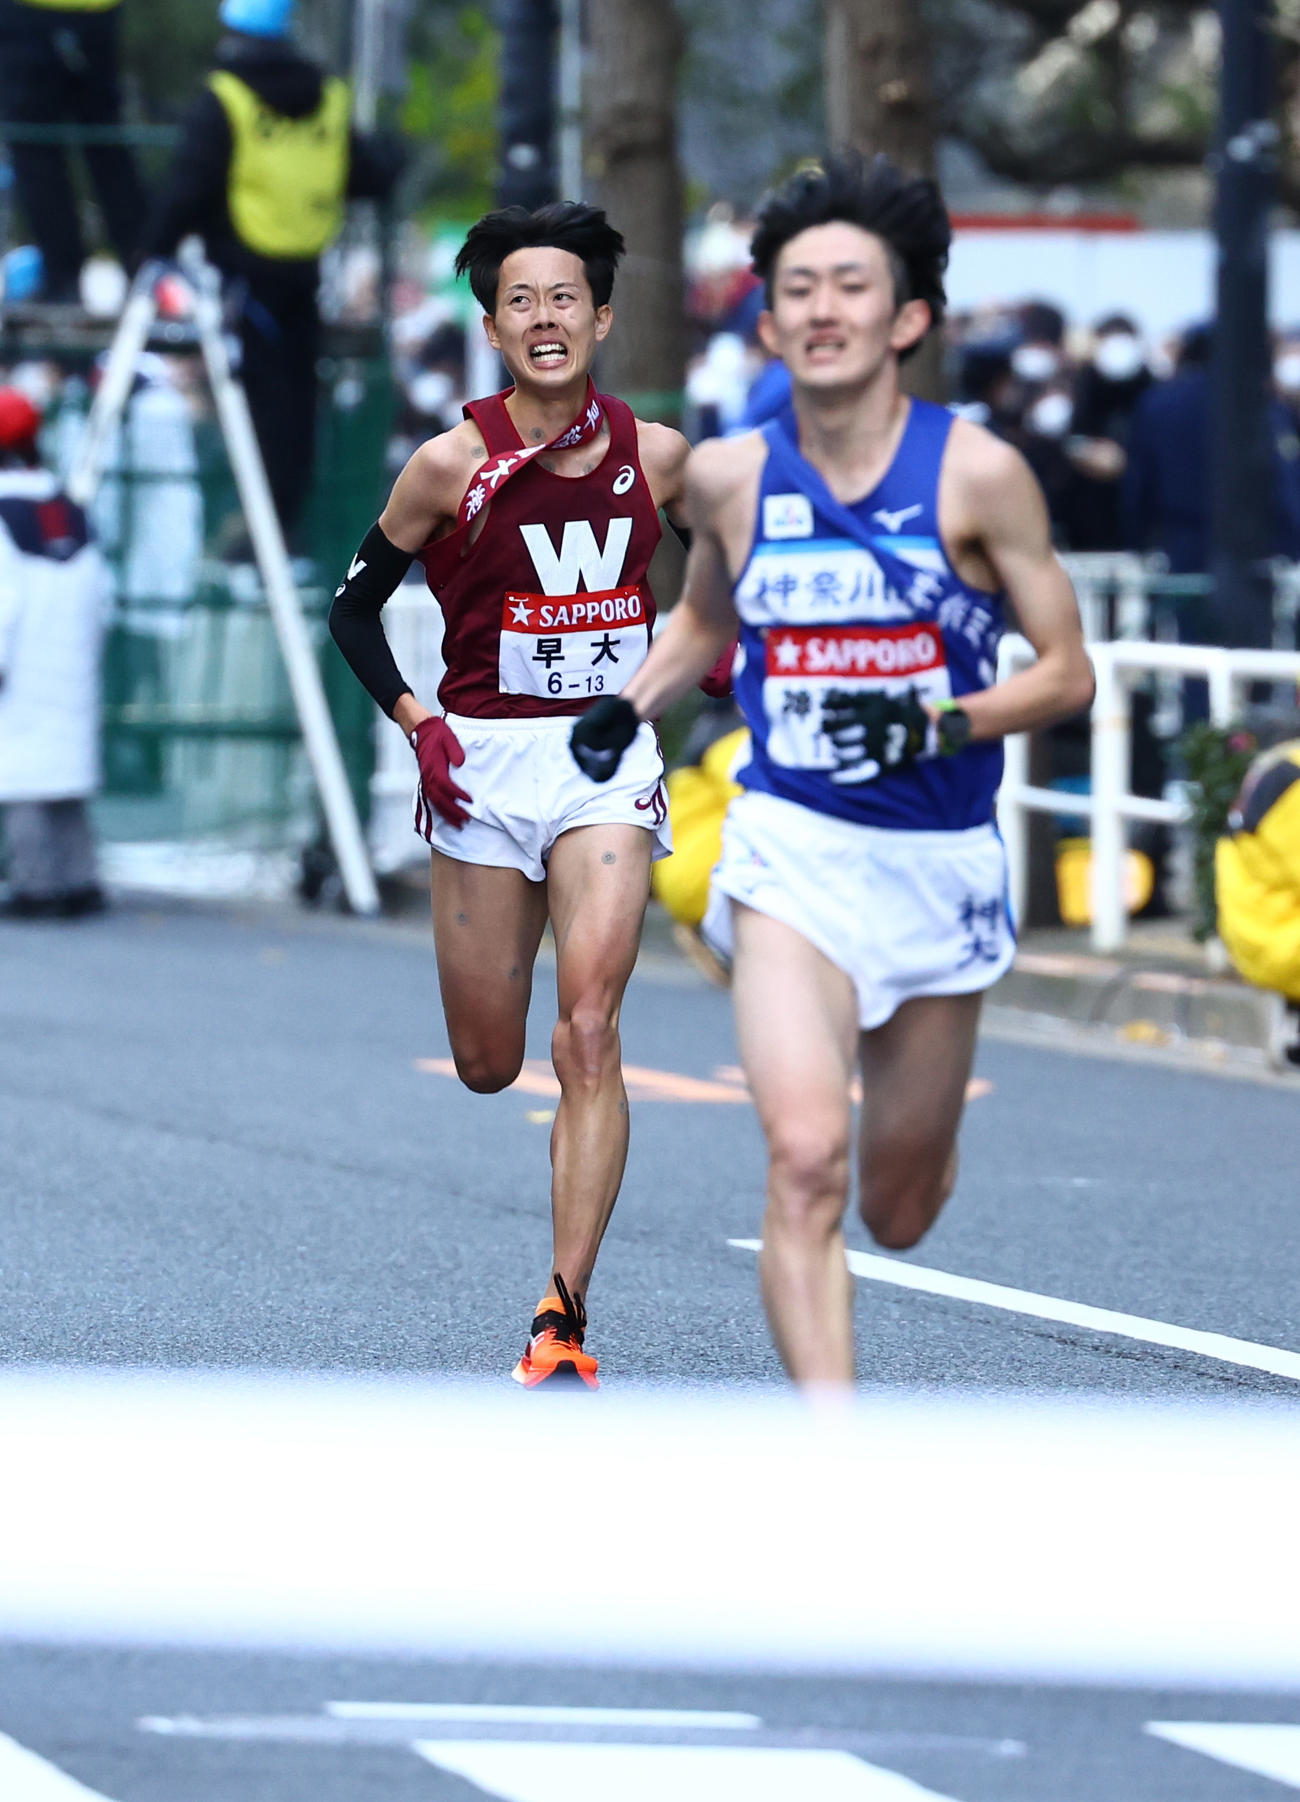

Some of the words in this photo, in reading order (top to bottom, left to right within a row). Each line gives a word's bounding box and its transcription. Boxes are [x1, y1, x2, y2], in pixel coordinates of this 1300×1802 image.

[465, 399, 600, 522] 早稲大学
[519, 516, 633, 597] W
[538, 595, 641, 628] SAPPORO
[804, 632, 936, 672] SAPPORO
[547, 671, 604, 694] 6-13
